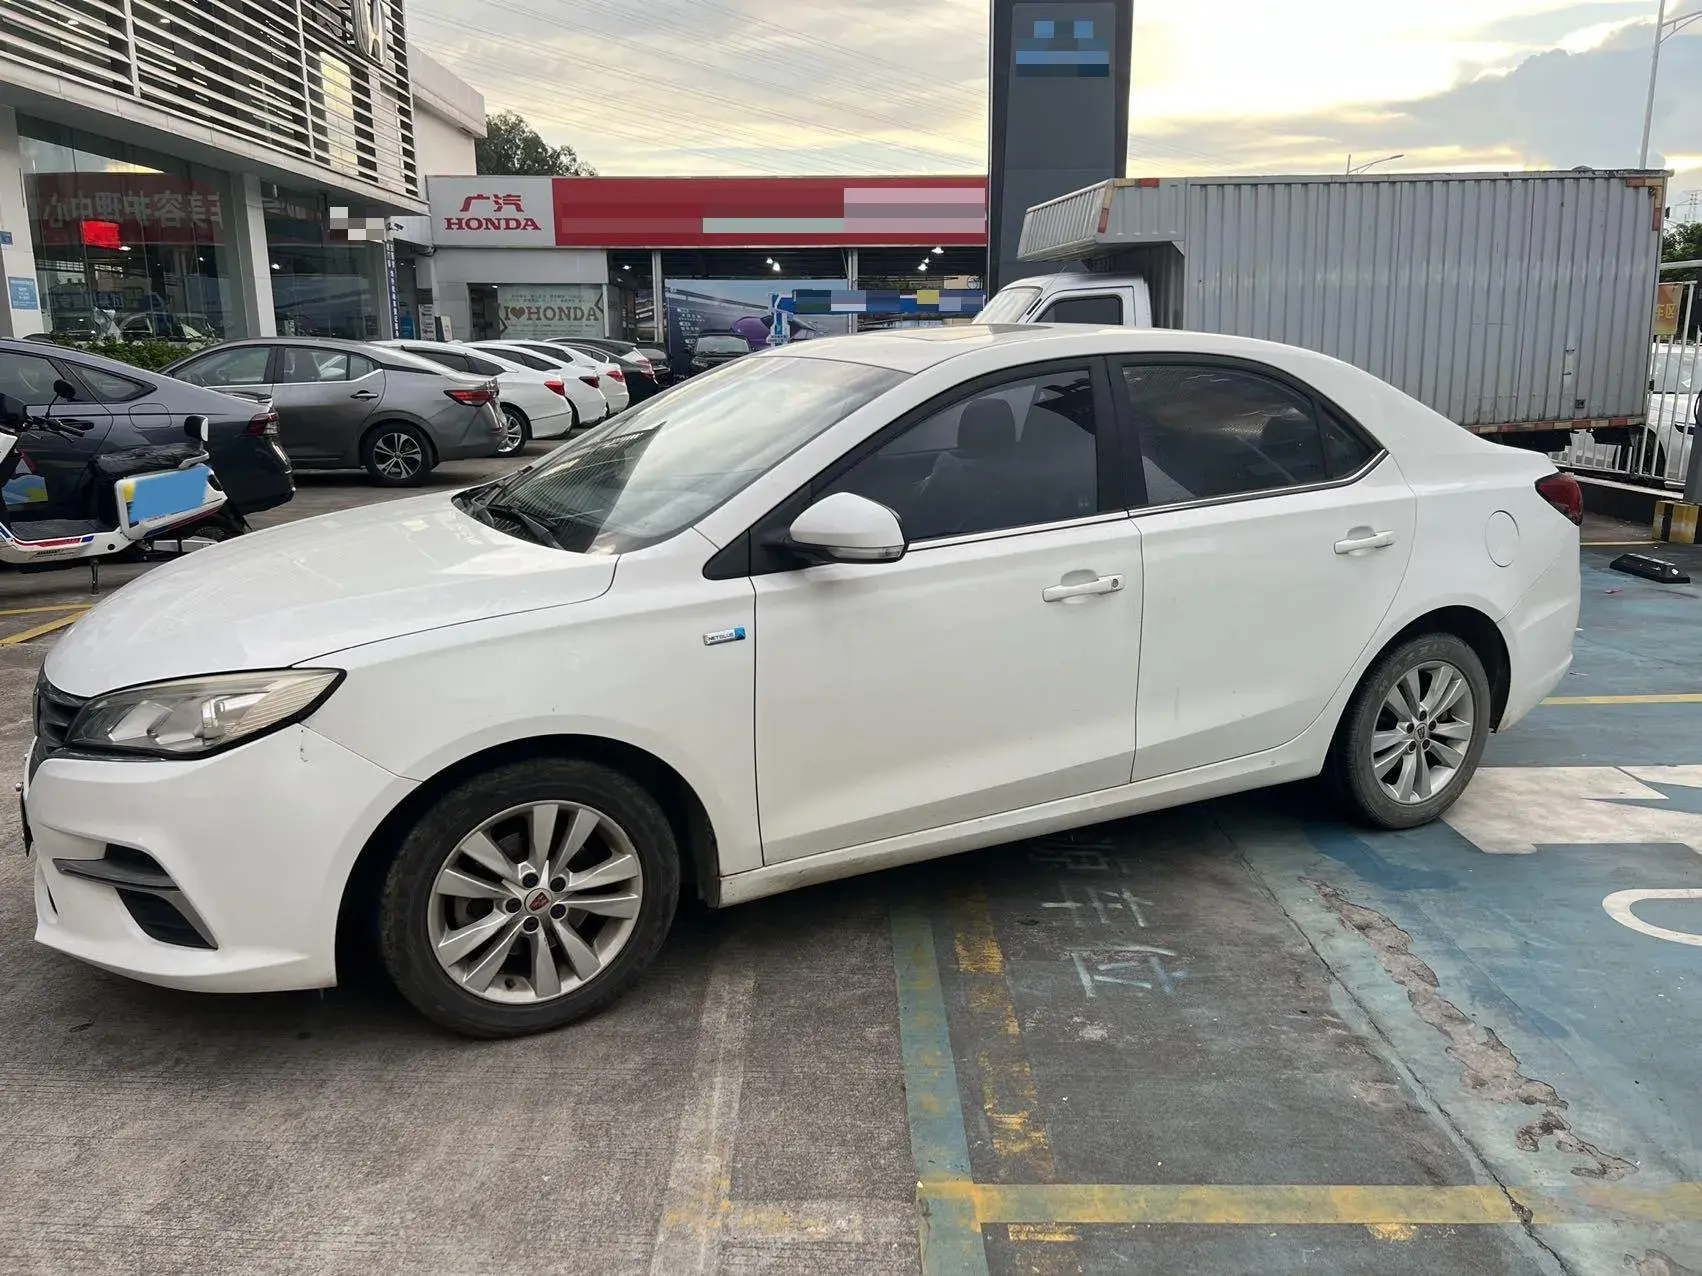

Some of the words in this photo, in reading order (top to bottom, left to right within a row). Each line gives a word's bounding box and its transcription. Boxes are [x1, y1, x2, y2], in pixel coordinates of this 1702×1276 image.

[460, 193, 524, 212] 广汽
[444, 217, 542, 231] HONDA
[504, 306, 511, 321] I
[527, 306, 601, 322] HONDA
